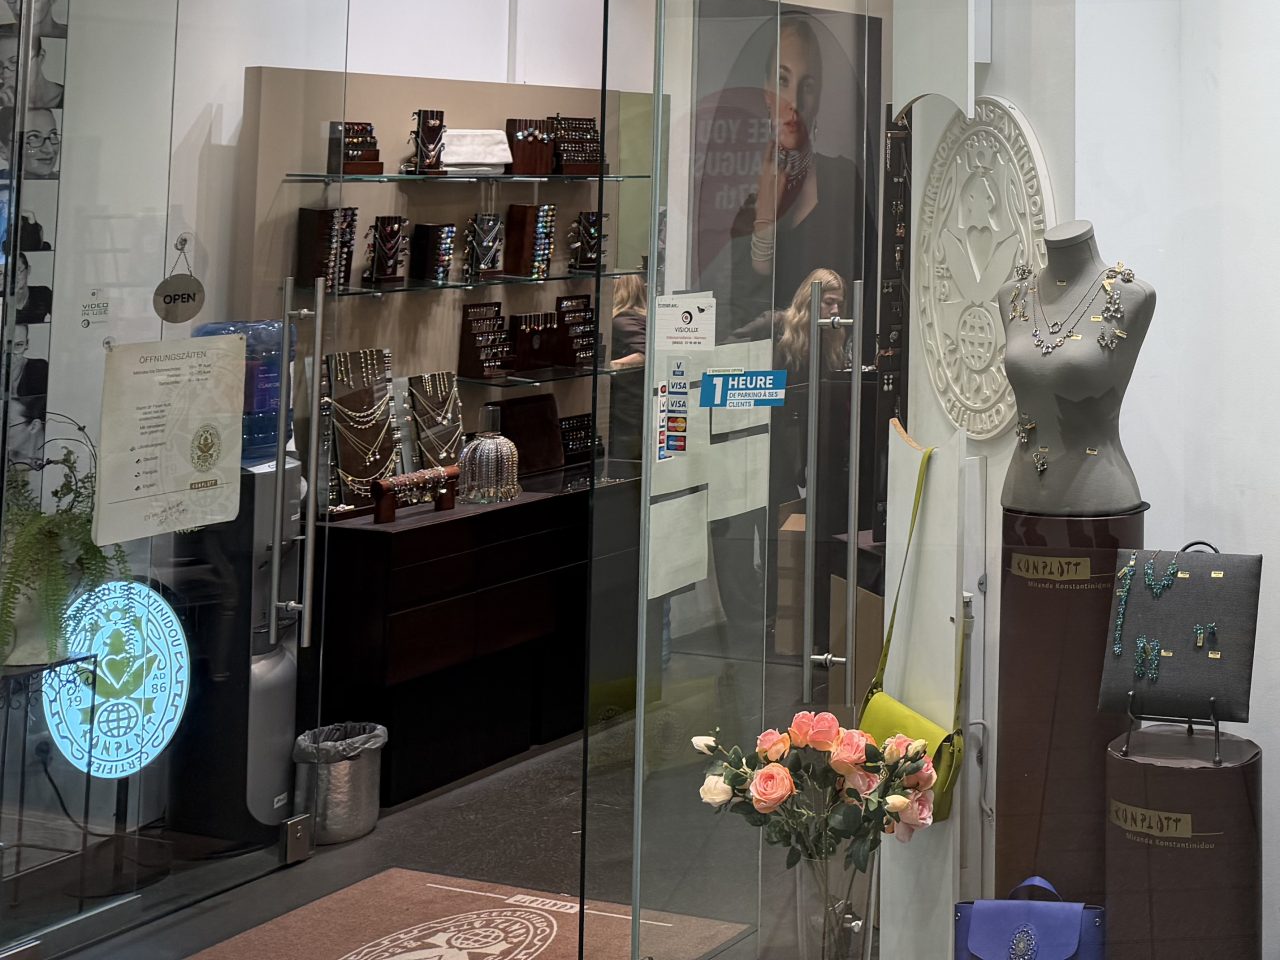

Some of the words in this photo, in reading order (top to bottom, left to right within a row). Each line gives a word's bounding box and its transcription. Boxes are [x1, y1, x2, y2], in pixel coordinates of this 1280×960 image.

[163, 292, 196, 306] OPEN
[671, 381, 687, 390] VISA
[713, 376, 724, 405] 1
[728, 376, 774, 389] HEURE
[670, 400, 687, 409] VISA
[1016, 559, 1082, 578] KONPLOTT
[152, 672, 166, 681] AD
[151, 682, 167, 694] 86
[1114, 806, 1182, 833] KONPLOTT
[1125, 832, 1153, 845] Miranda
[1156, 838, 1215, 849] Konstantinidou
